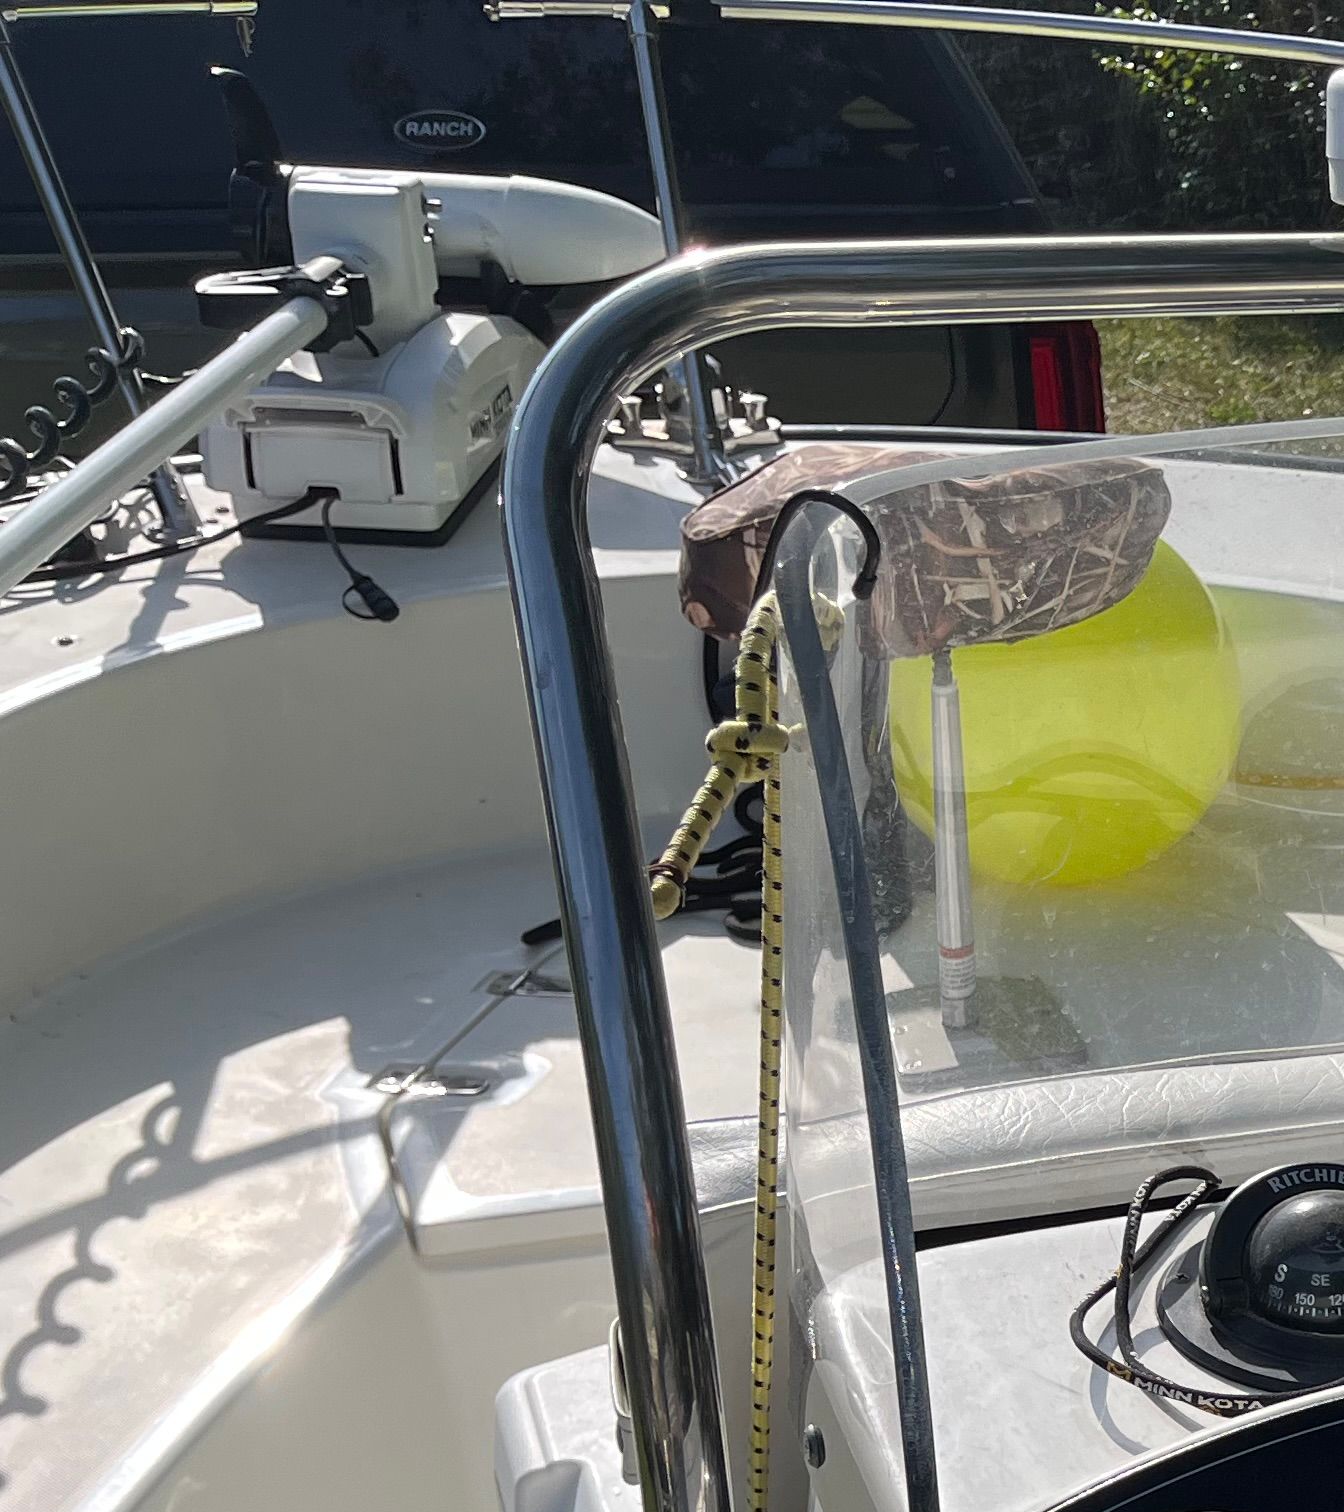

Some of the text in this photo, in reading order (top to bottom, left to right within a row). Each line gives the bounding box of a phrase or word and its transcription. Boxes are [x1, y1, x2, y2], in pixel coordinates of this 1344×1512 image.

[405, 120, 474, 137] RANCH
[1274, 1263, 1289, 1283] S
[1310, 1273, 1331, 1287] SE
[1294, 1292, 1316, 1306] 150
[1133, 1375, 1265, 1411] MINN KOTA
